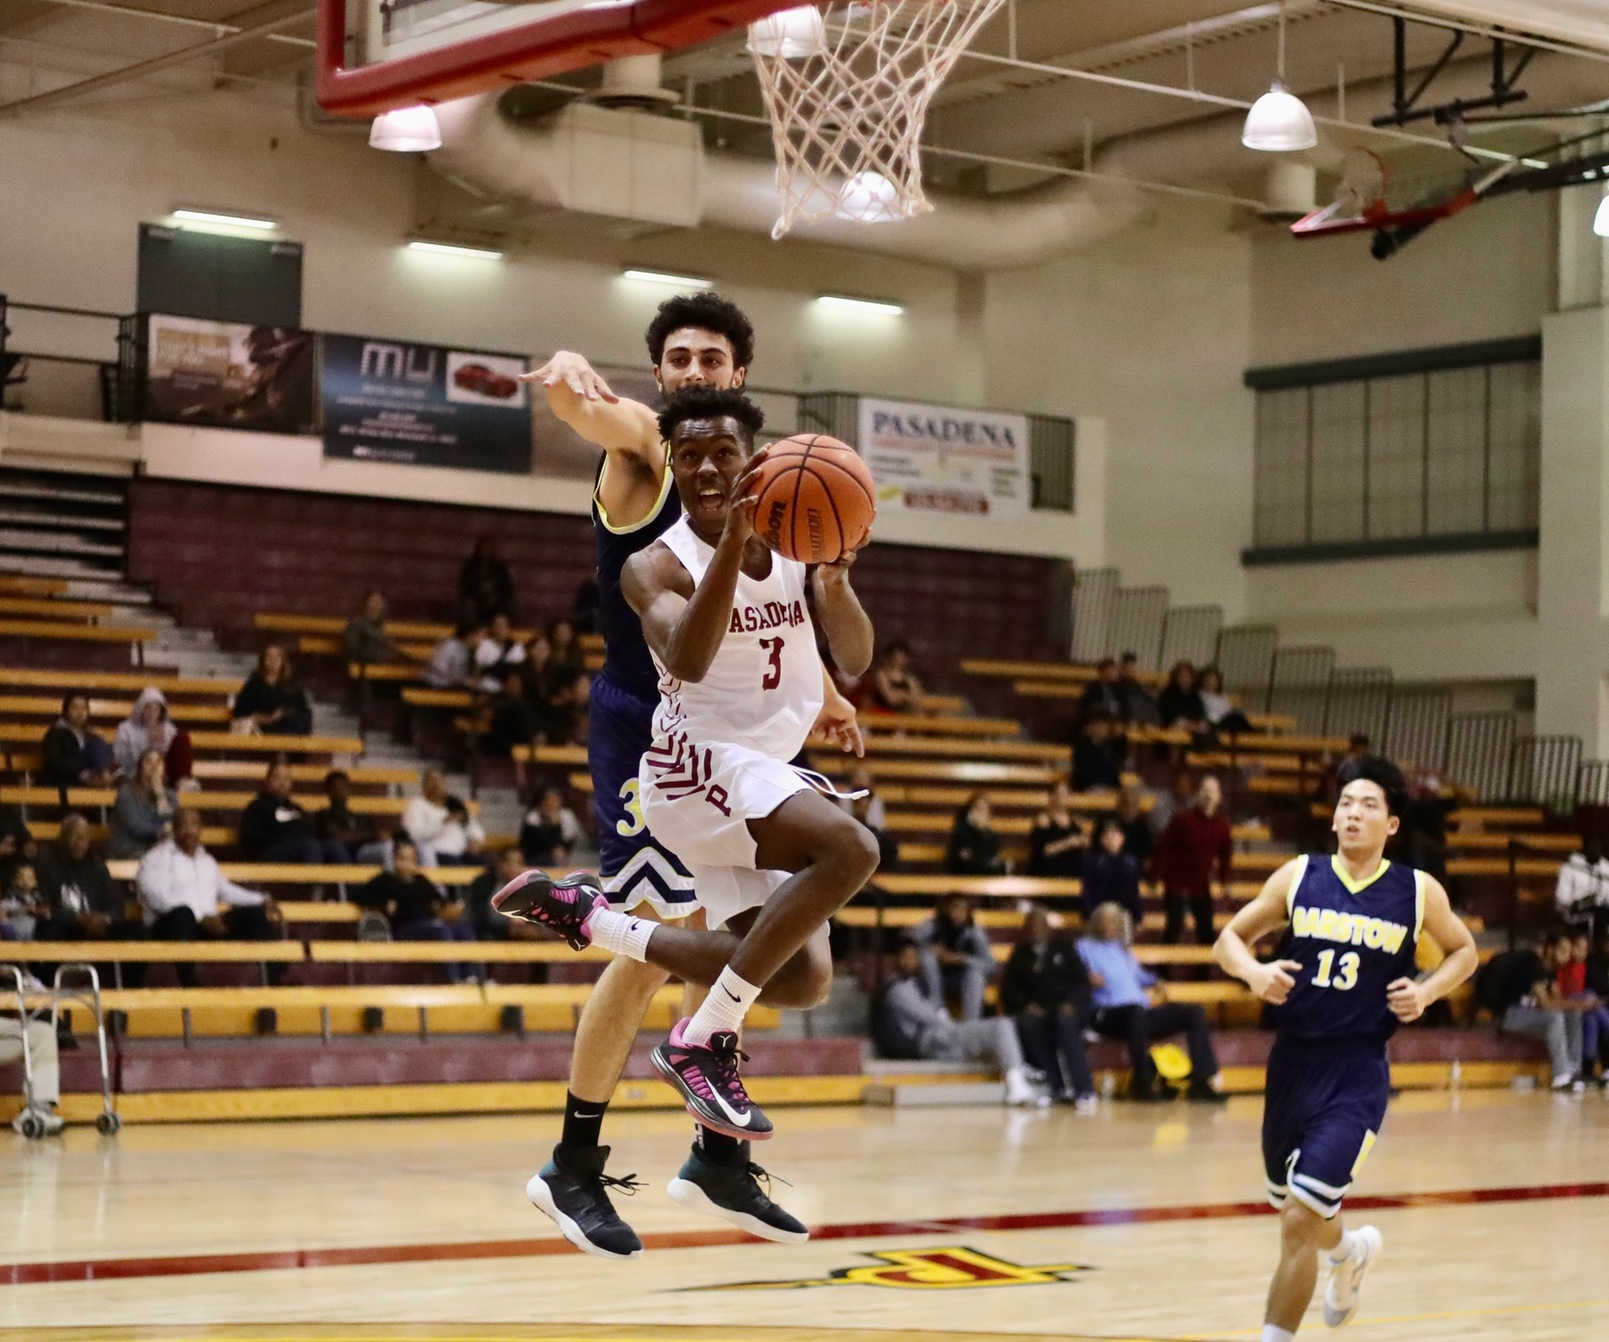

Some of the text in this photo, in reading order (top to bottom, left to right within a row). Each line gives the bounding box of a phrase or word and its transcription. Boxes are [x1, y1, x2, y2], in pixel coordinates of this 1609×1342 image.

[872, 410, 1016, 449] PASADENA
[763, 501, 787, 551] lson
[728, 600, 805, 633] ASADEA
[759, 636, 785, 691] 3
[705, 784, 732, 817] P
[1292, 905, 1408, 955] BARSTOW
[1311, 948, 1361, 991] 13
